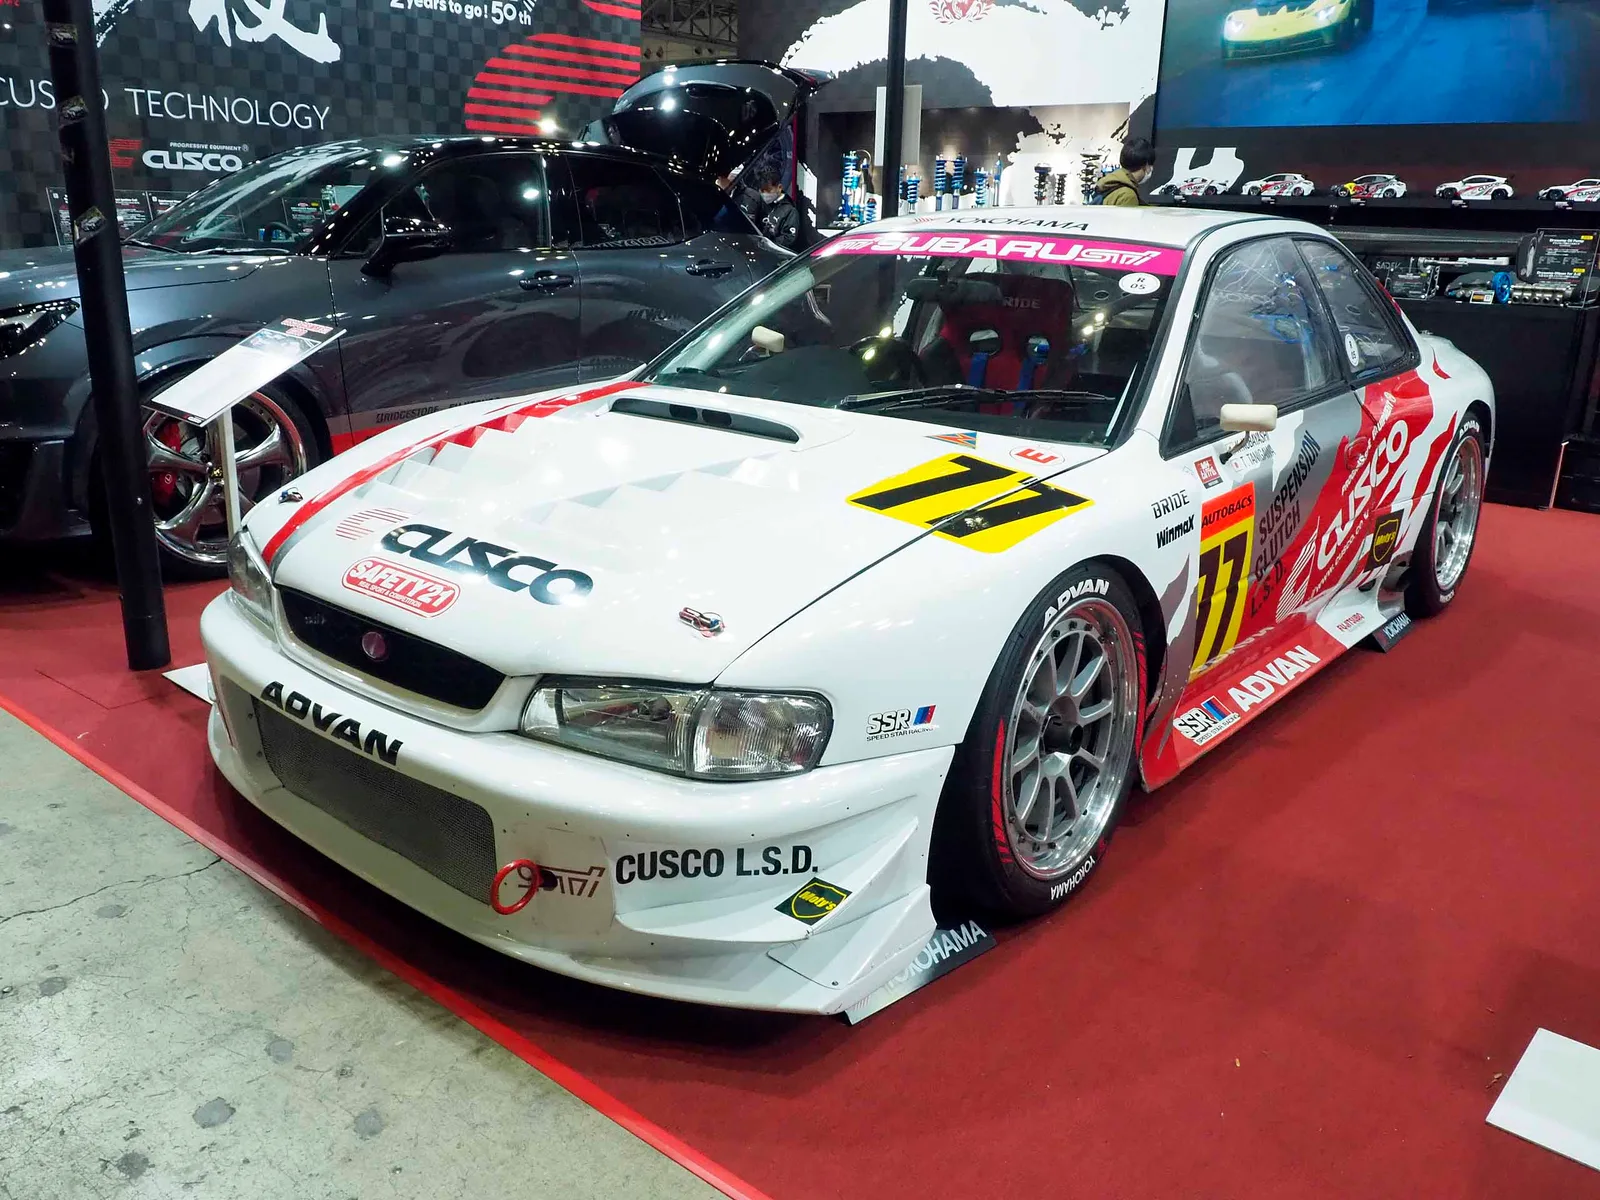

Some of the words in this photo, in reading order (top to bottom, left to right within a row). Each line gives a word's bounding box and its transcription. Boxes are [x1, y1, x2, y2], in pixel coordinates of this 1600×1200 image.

[449, 1, 462, 14] to
[464, 4, 488, 19] go!
[124, 88, 330, 130] TECHNOLOGY
[142, 150, 243, 172] CUSCO
[170, 141, 208, 149] PROGRESSIVE
[947, 217, 1090, 231] YOKOHAMA
[870, 235, 1083, 261] SUBARU
[1003, 296, 1041, 310] RIDE
[1151, 489, 1190, 519] BRIDE
[1259, 430, 1321, 546] SUSPENSION
[1201, 495, 1253, 528] AUTOBACS
[1254, 499, 1301, 583] CLUTCH
[381, 523, 593, 606] CUSCO
[349, 560, 455, 607] SAFETY21
[1192, 530, 1248, 668] 77
[1043, 578, 1110, 629] ADVAN
[1227, 645, 1321, 712] ADVAN
[260, 681, 404, 766] ADVAN
[866, 708, 911, 736] SSR
[866, 733, 889, 741] SPEED
[1173, 708, 1218, 738] SSR
[615, 848, 724, 885] CUSCO
[736, 845, 818, 878] L.S.D.
[1050, 856, 1096, 900] YOKOHAMA
[798, 890, 837, 911] Moty's
